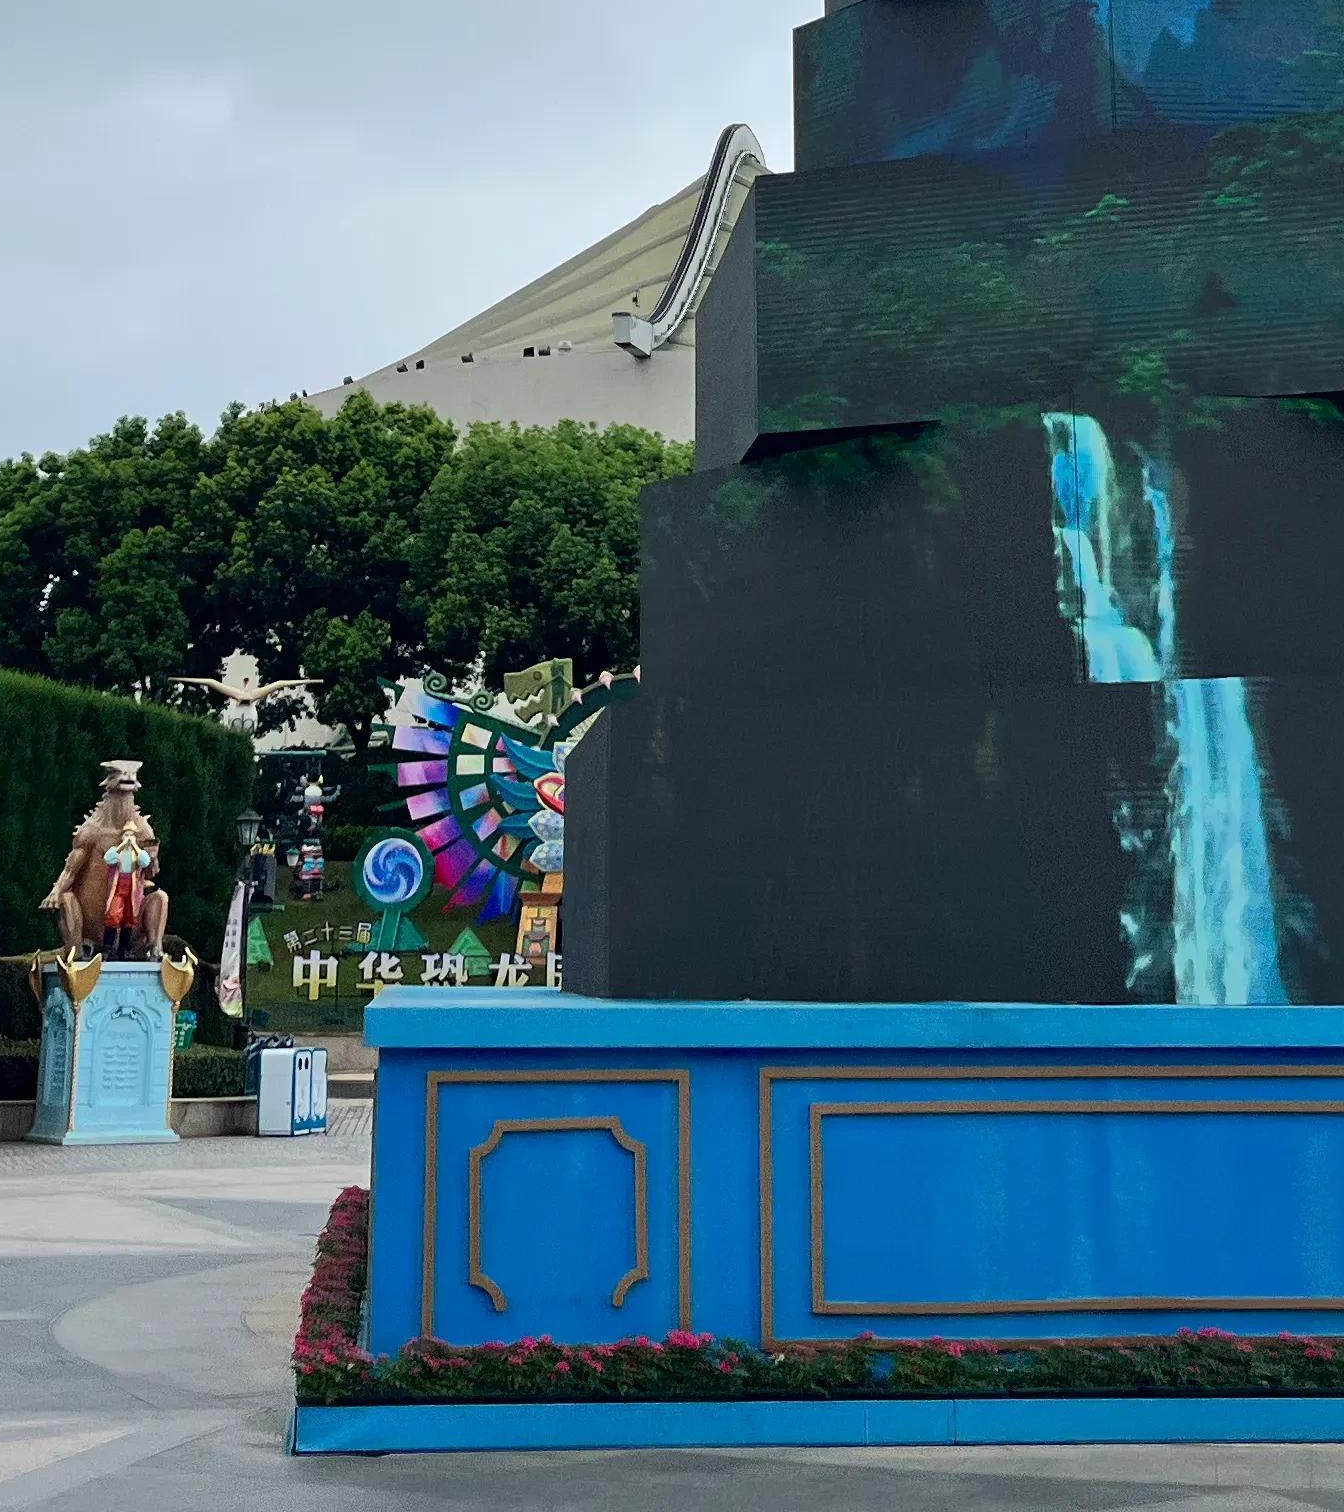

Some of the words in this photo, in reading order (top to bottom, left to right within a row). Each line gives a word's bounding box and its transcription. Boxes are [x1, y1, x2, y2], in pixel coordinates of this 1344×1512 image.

[283, 921, 372, 953] 第二十三届
